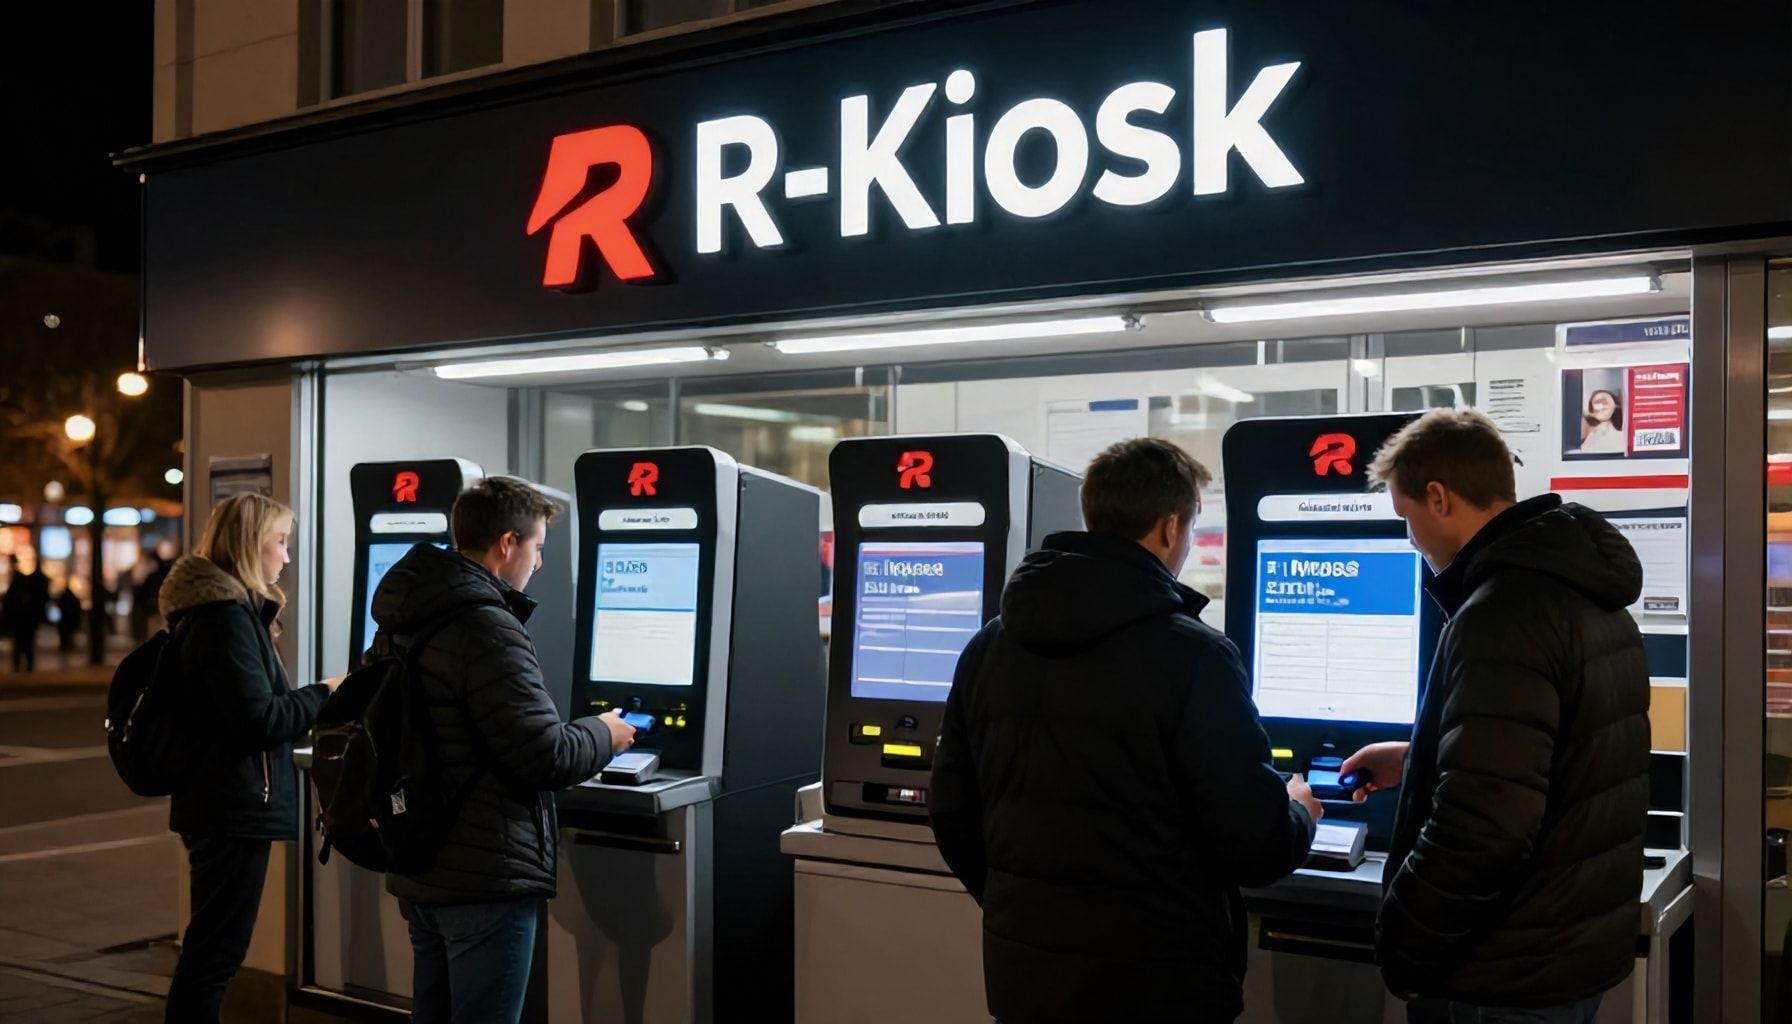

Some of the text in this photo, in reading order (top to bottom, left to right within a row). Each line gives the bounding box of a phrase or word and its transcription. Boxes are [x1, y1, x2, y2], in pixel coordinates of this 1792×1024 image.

[526, 27, 1305, 286] R R-Kiosk
[628, 462, 659, 496] R
[896, 451, 934, 489] R
